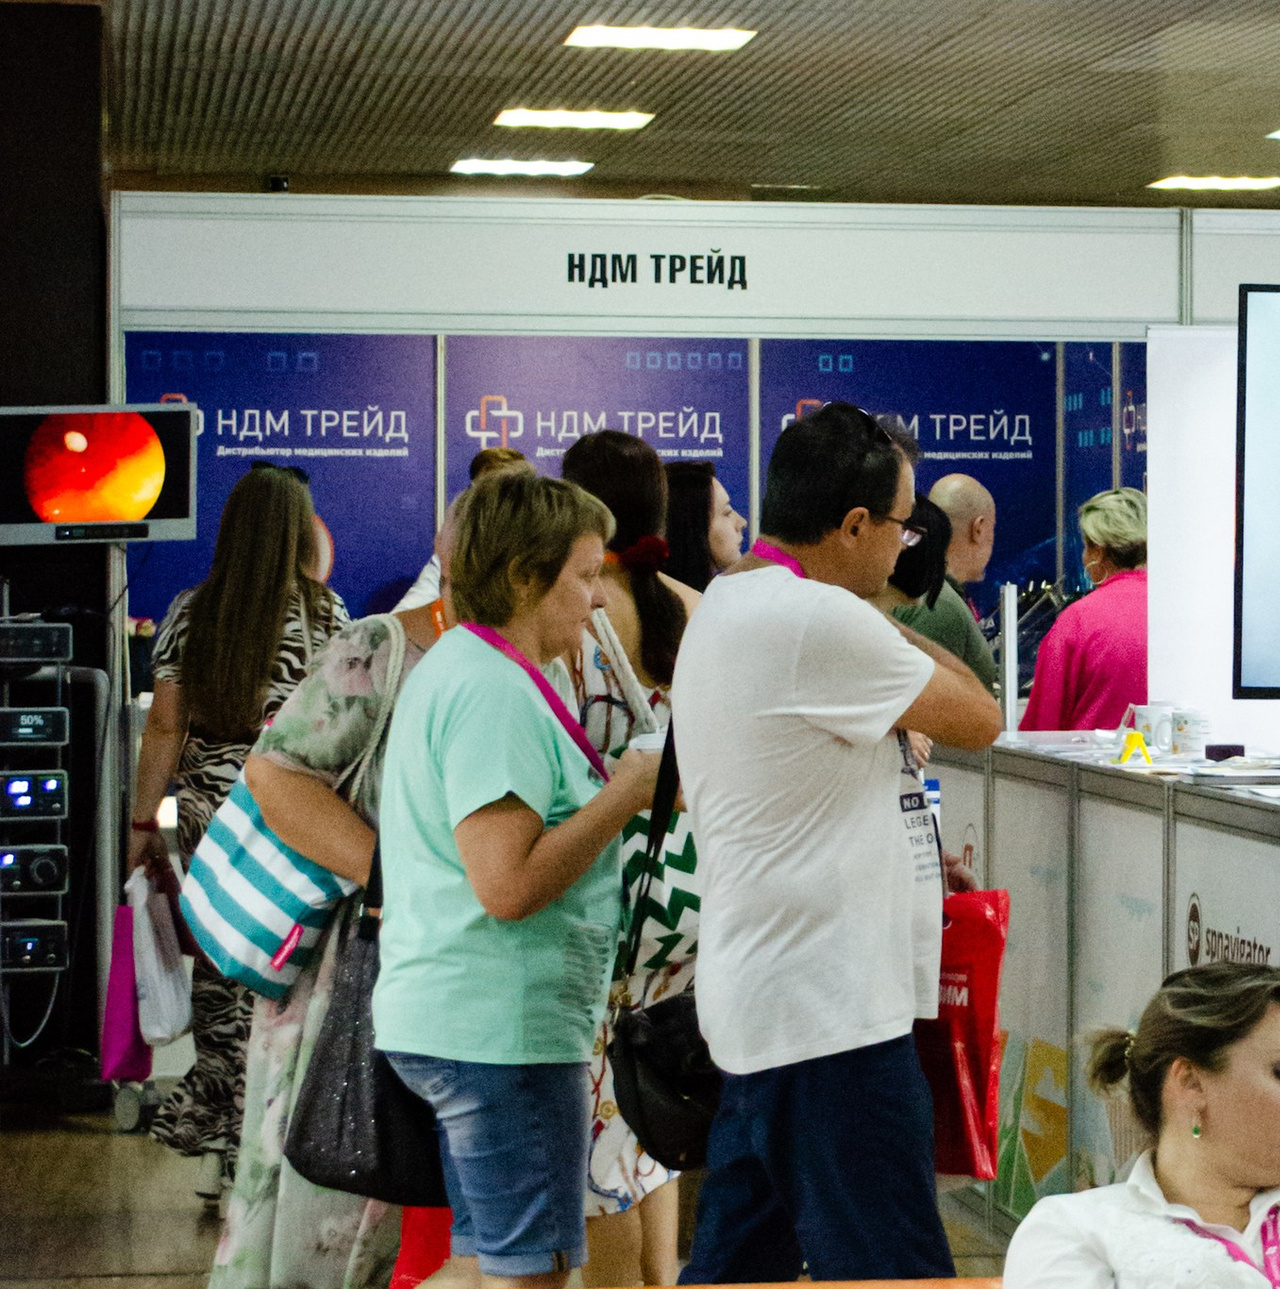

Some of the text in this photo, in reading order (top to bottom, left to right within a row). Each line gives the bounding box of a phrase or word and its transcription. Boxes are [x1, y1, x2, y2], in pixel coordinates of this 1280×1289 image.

[567, 248, 747, 290] НДМ ТРЕЙД
[217, 405, 409, 444] НДМ ТРЕЙД
[536, 406, 723, 444] НДМ ТРЕЙД
[929, 409, 1033, 446] ТРЕЙД
[216, 445, 409, 458] Дистрибьютор медицинских изделий
[20, 714, 45, 726] 50%
